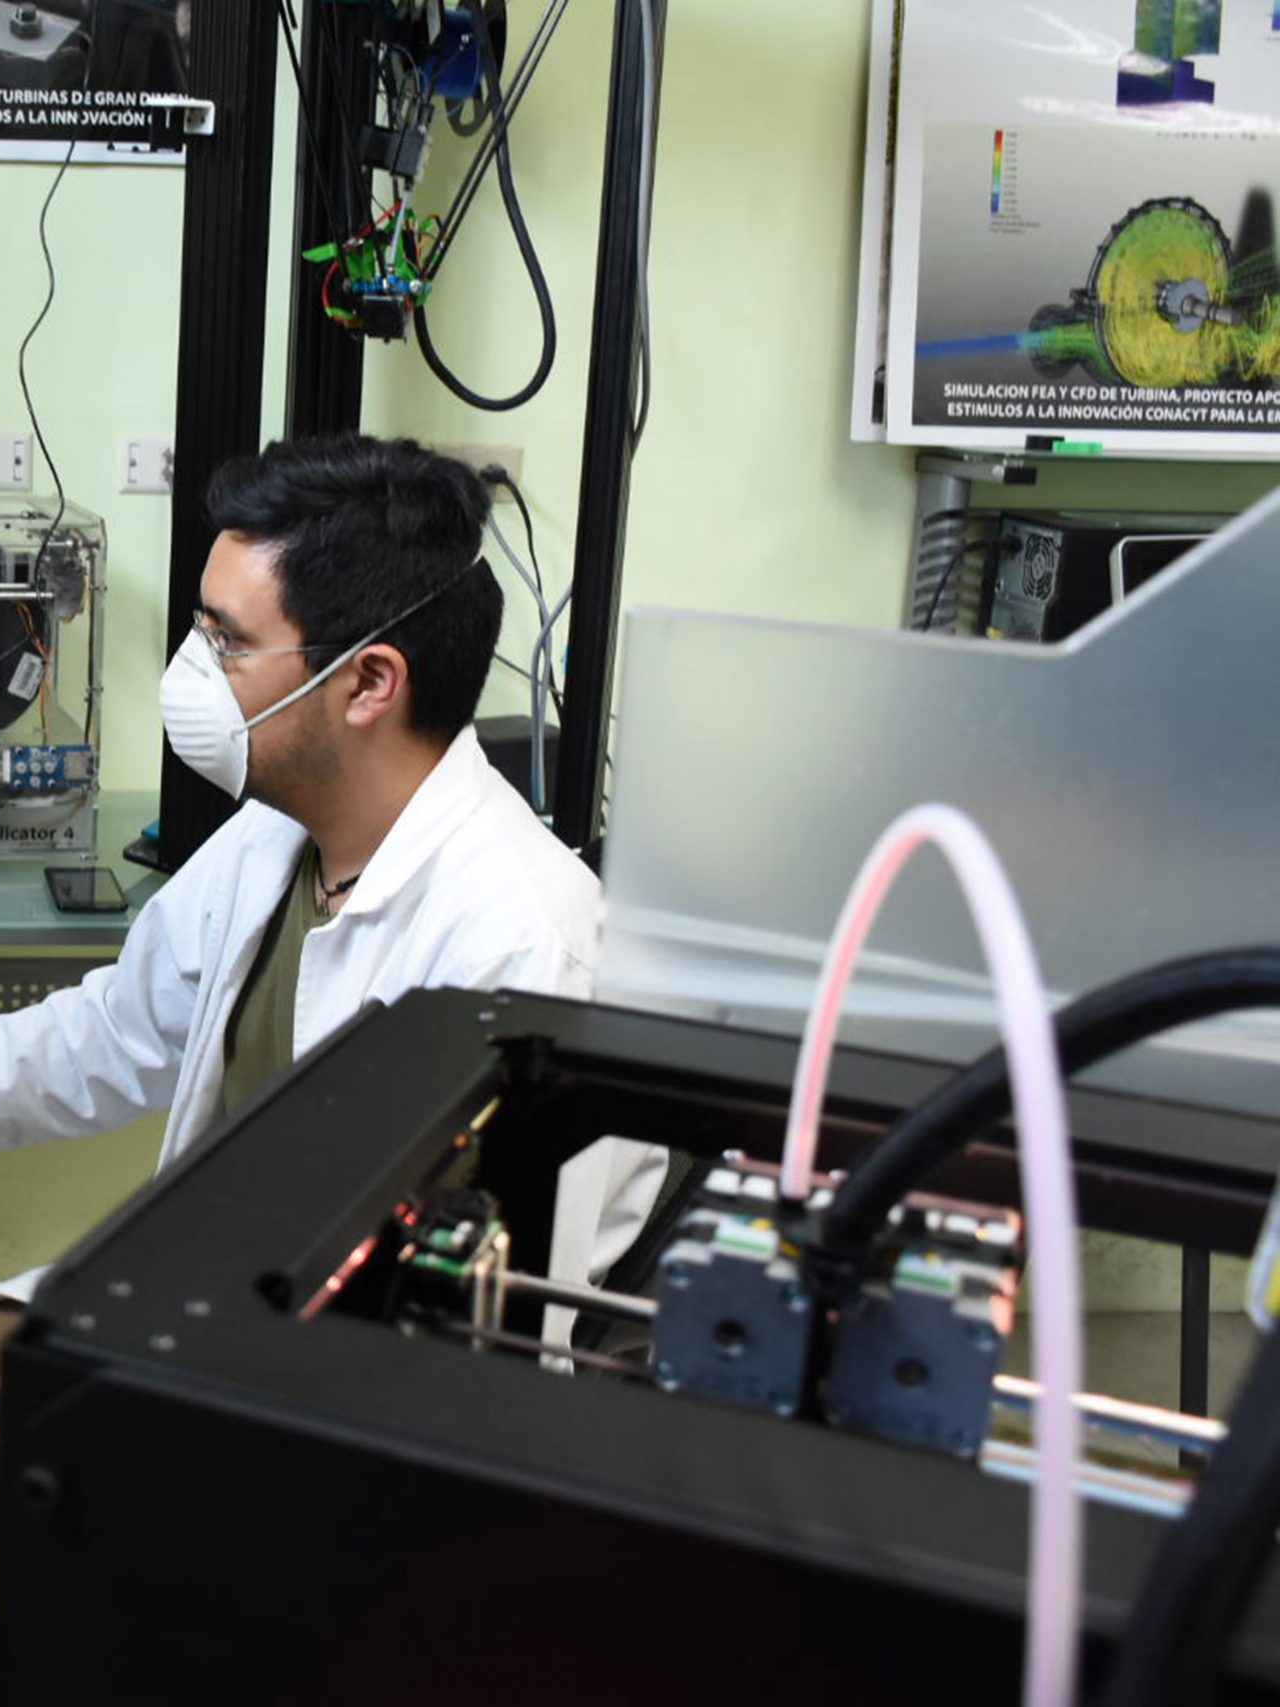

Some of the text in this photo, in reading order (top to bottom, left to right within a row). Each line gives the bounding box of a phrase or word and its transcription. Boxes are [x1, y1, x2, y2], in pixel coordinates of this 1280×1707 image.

[94, 91, 137, 107] GRAN
[15, 109, 26, 124] A
[28, 109, 48, 124] LA
[944, 383, 1029, 400] SIMULACION
[1032, 385, 1056, 400] FEA
[1059, 386, 1068, 400] Y
[1070, 386, 1097, 401] CFD
[1099, 387, 1117, 402] DE
[1184, 389, 1253, 404] PROYECTO
[947, 402, 1023, 418] ESTIMULOS
[1026, 403, 1035, 418] A
[1038, 404, 1055, 419] LA
[1058, 403, 1143, 421] INNOVACIÓN
[1145, 406, 1208, 422] CONACYT
[1210, 408, 1245, 423] PARA
[1247, 409, 1264, 424] LA
[63, 825, 75, 842] 4
